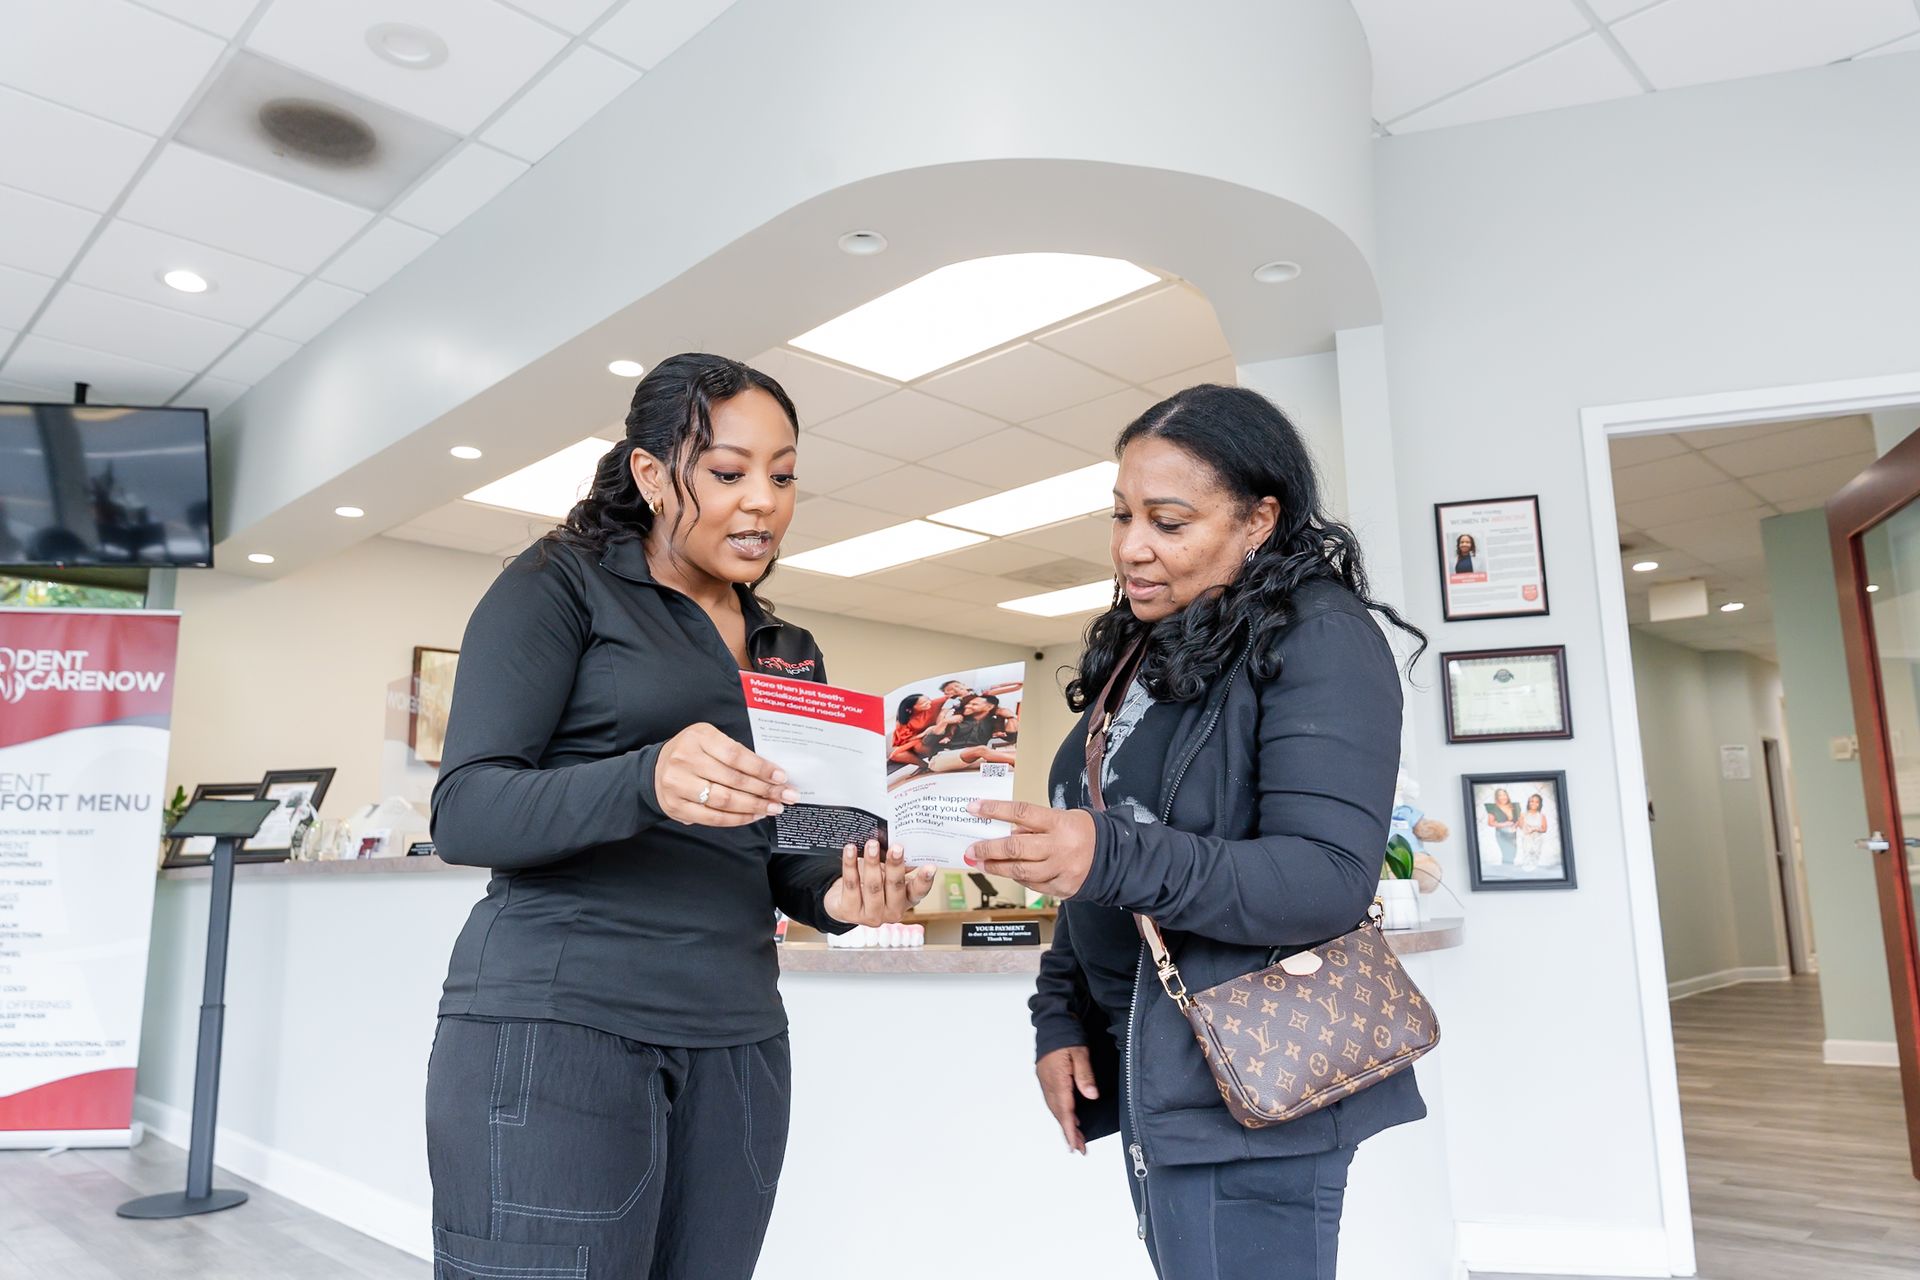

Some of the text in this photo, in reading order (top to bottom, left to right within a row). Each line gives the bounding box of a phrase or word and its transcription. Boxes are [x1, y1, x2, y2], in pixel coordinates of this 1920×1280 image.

[15, 650, 89, 671] DENT
[26, 671, 165, 693] CARENOW
[750, 678, 845, 703] More than just teeth:
[752, 687, 864, 715] Specialized care for your
[754, 696, 846, 719] unique dental needs
[1, 794, 151, 812] FORT MENU
[895, 798, 921, 812] When
[921, 805, 938, 813] got
[940, 805, 958, 813] you
[894, 817, 944, 830] plan today!
[932, 813, 992, 826] membership
